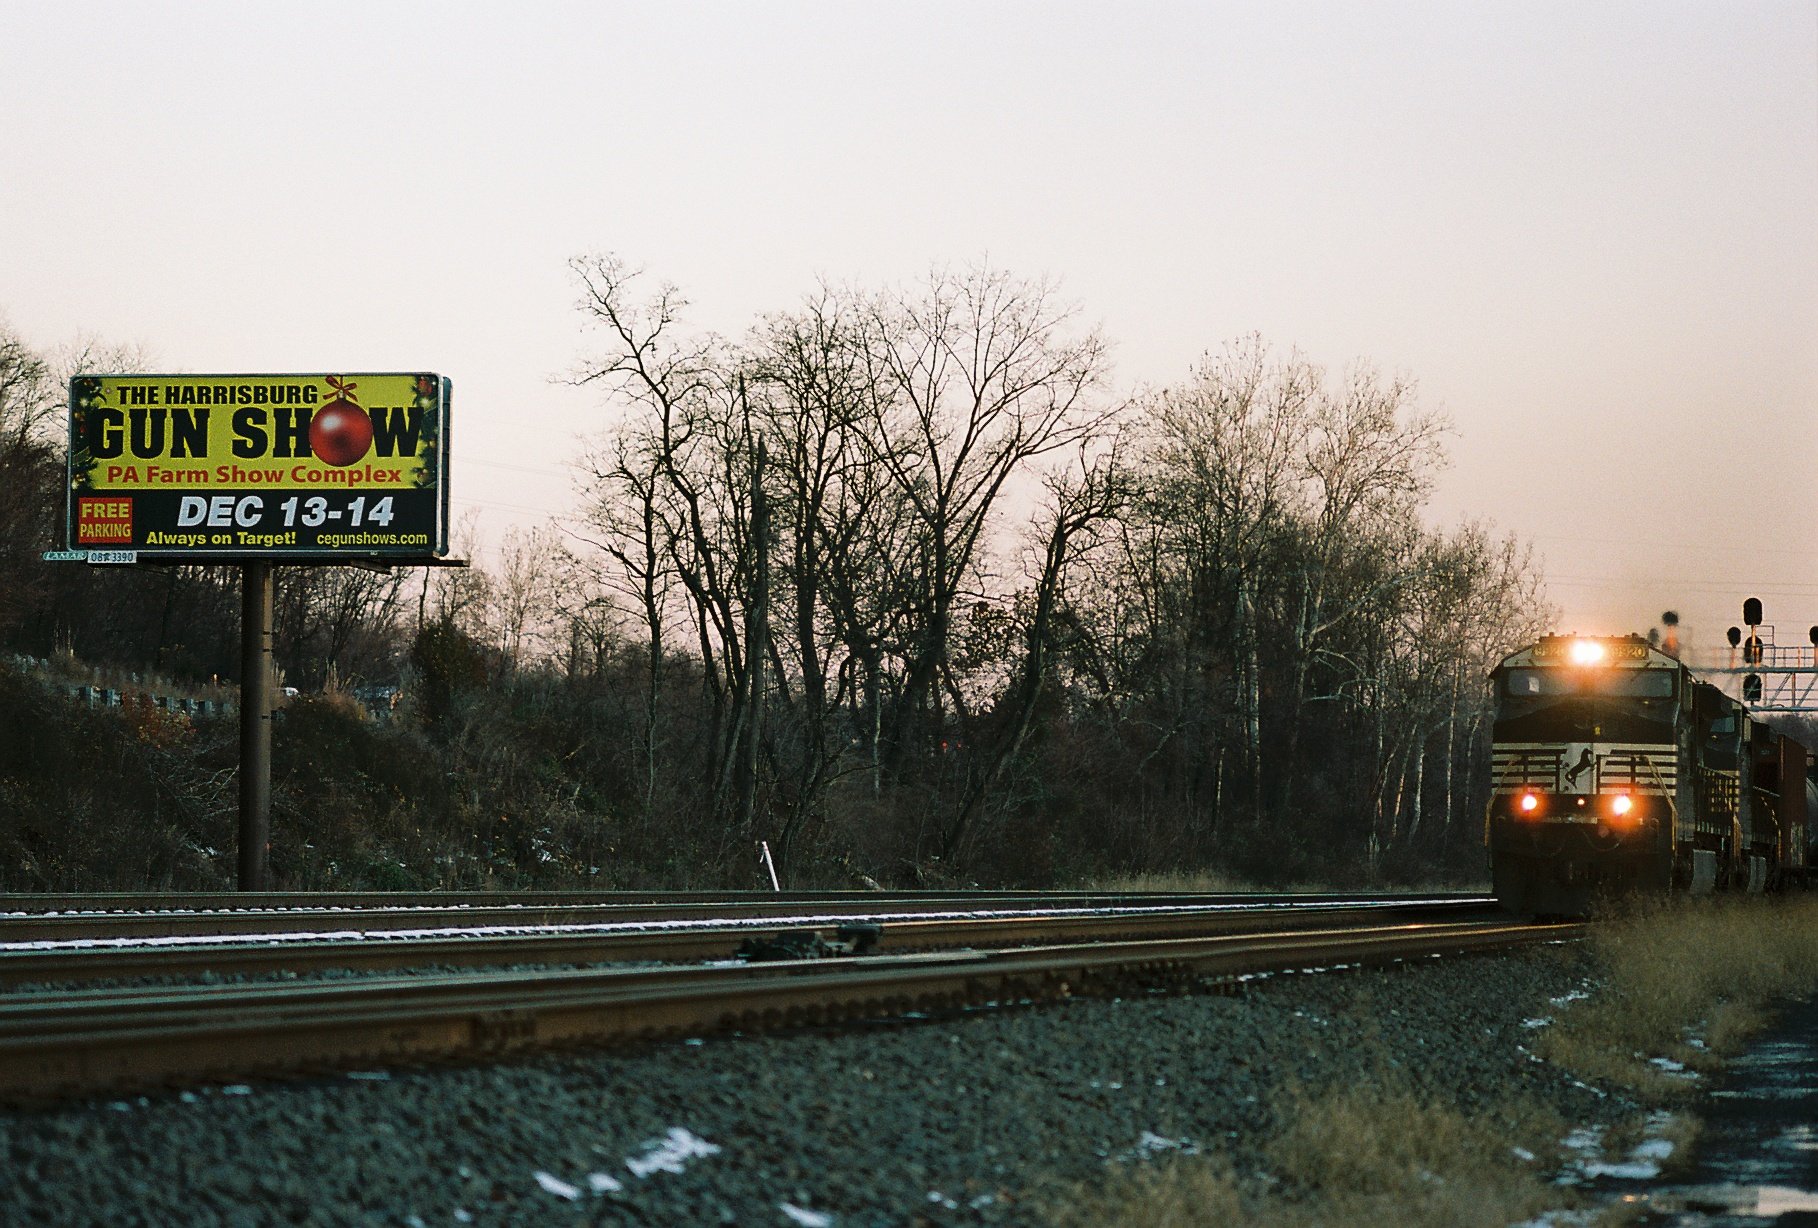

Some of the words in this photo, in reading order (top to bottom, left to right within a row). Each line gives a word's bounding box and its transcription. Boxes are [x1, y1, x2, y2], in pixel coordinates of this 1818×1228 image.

[117, 386, 159, 404] THE
[165, 385, 318, 404] HARRISBURG
[91, 407, 210, 459] GUN
[108, 466, 140, 483] PA
[147, 466, 209, 483] Farm
[216, 465, 284, 483] Show
[290, 465, 402, 487] Complex
[81, 503, 130, 518] FREE
[177, 495, 264, 527] DEC
[280, 496, 394, 527] 13-14
[80, 523, 132, 538] PARKING
[146, 531, 207, 547] Always
[211, 533, 232, 545] on
[237, 531, 297, 547] Target!
[317, 531, 428, 547] cegunshows.com
